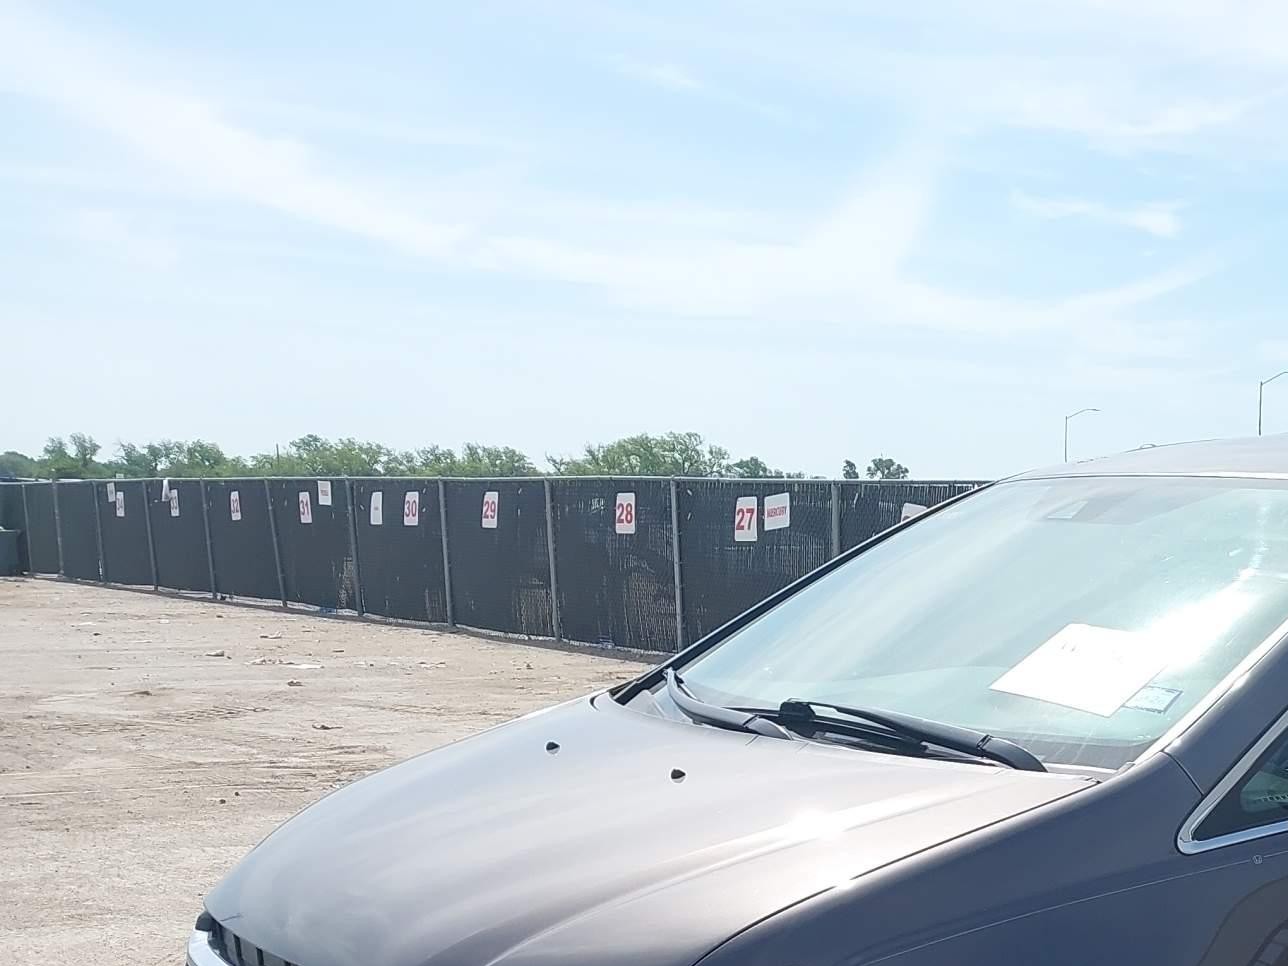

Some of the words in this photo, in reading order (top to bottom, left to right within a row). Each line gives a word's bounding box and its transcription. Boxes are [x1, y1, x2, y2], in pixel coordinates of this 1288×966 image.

[231, 499, 240, 514] 32
[299, 499, 310, 516] 31
[404, 500, 417, 518] 30
[482, 501, 497, 520] 29
[616, 503, 633, 524] 28
[736, 508, 755, 530] 27
